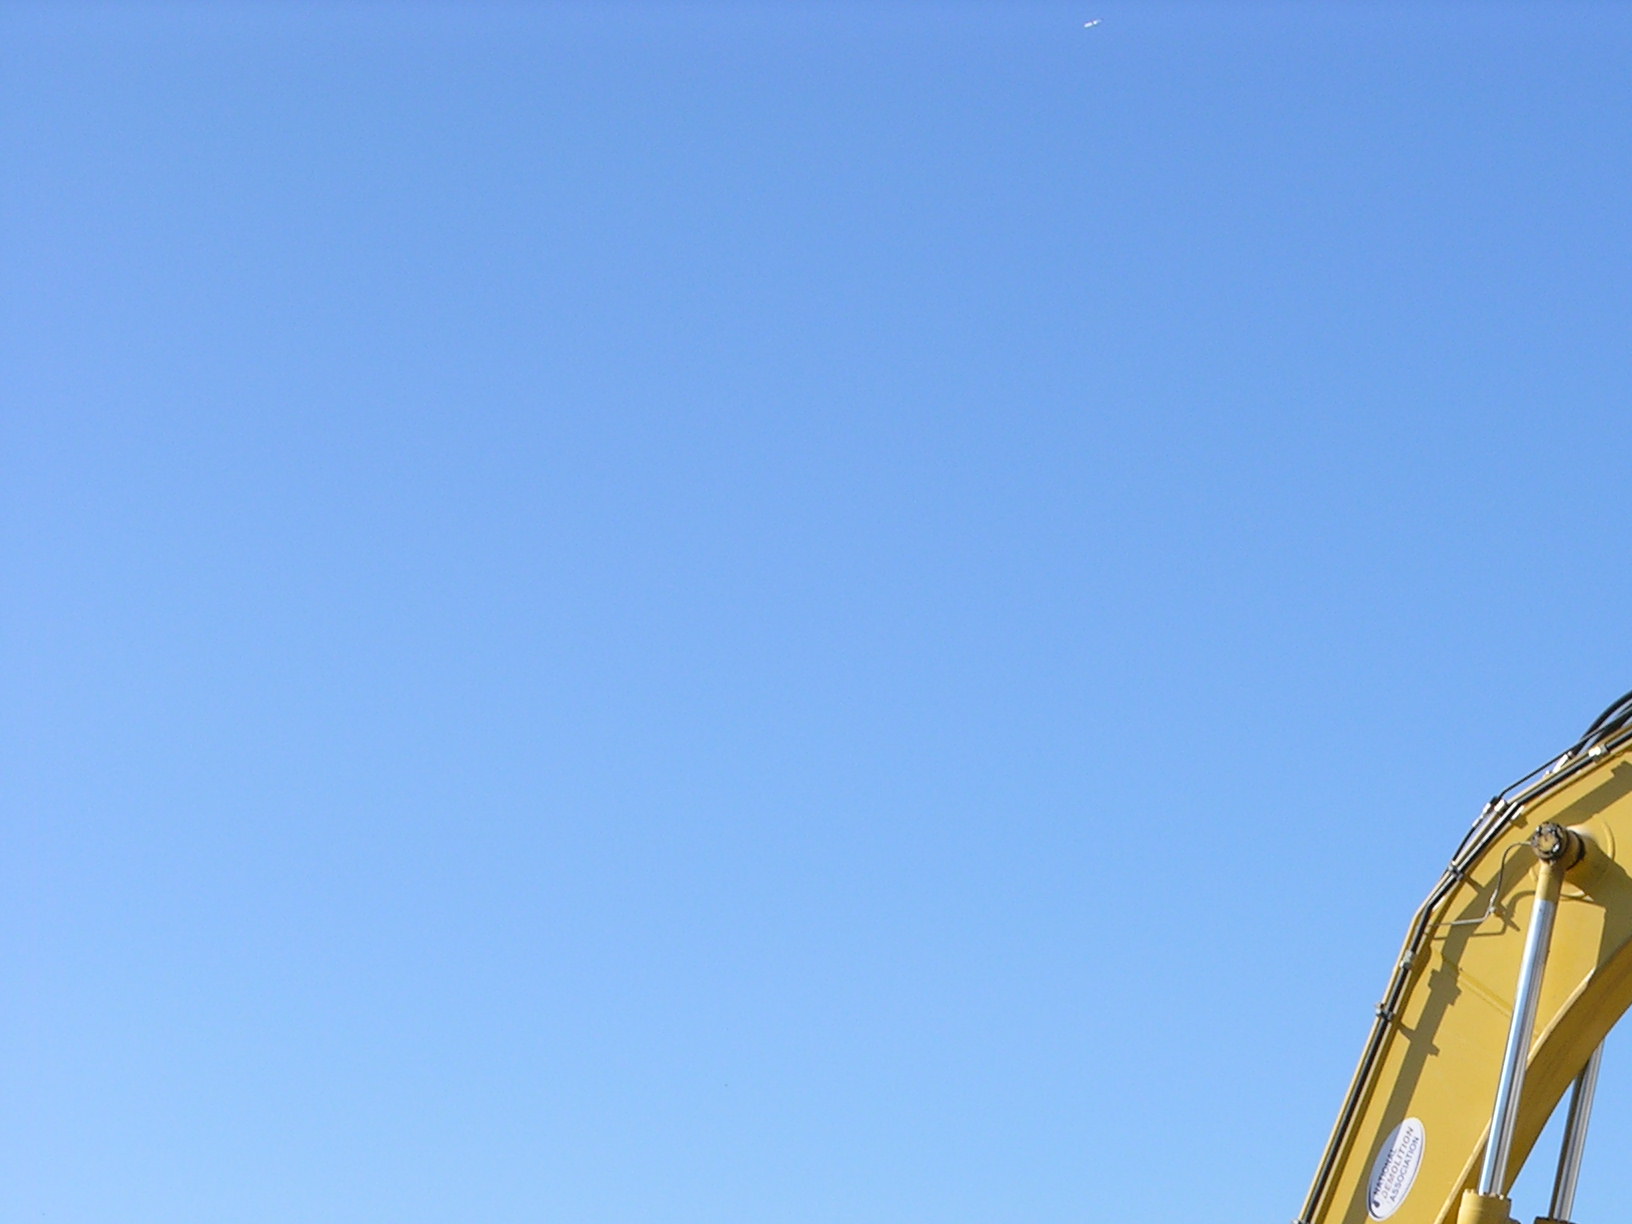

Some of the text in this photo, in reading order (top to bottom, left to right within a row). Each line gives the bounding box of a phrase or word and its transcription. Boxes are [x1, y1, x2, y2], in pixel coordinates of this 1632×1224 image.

[1373, 1147, 1397, 1196] NATIONAL
[1381, 1126, 1414, 1199] DEMOLITION
[1389, 1137, 1419, 1203] ASSOCIATION
